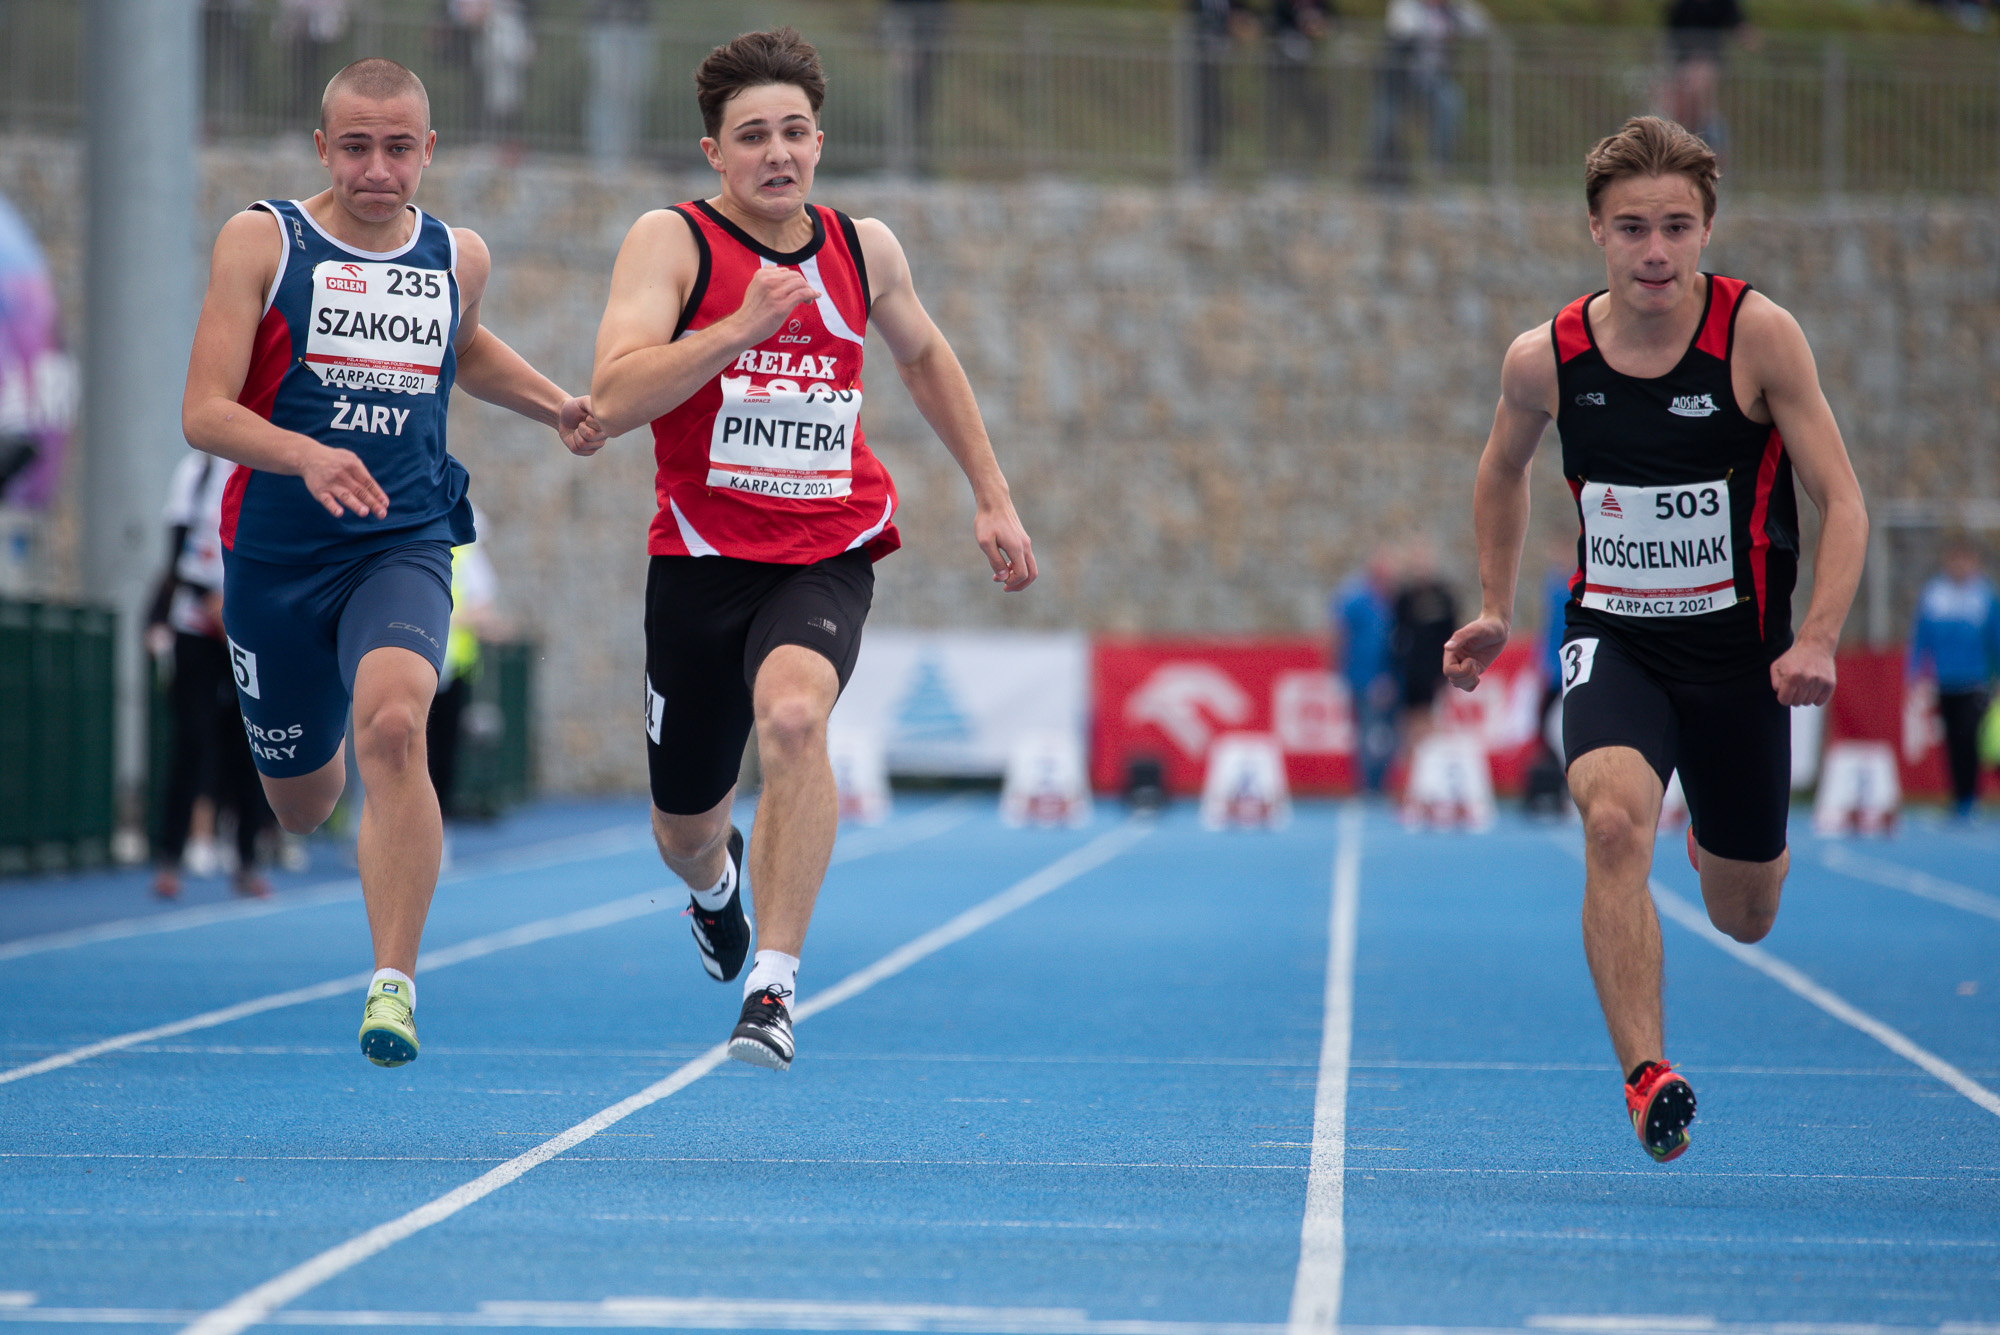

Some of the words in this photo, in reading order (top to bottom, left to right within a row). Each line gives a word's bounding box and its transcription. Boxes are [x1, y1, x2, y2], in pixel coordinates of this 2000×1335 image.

[328, 278, 365, 292] ORLEN
[386, 268, 441, 299] 235
[316, 307, 443, 347] SZAKOŁA
[778, 334, 812, 344] COLO
[325, 367, 395, 386] KARPACZ
[399, 375, 425, 390] 2021
[734, 349, 837, 380] RELAX
[330, 395, 411, 436] ŻARY
[722, 416, 846, 451] PINTERA
[729, 476, 801, 495] KARPACZ
[804, 482, 833, 496] 2021
[1601, 511, 1624, 520] KARPACZ
[1655, 488, 1720, 520] 503
[1591, 534, 1728, 569] KOŚCIELNIAK
[1605, 598, 1675, 614] KARPACZ
[1679, 597, 1713, 613] 2021
[387, 622, 440, 649] COLO
[233, 645, 250, 688] 5
[1566, 644, 1583, 688] 3
[243, 716, 303, 742] GROS
